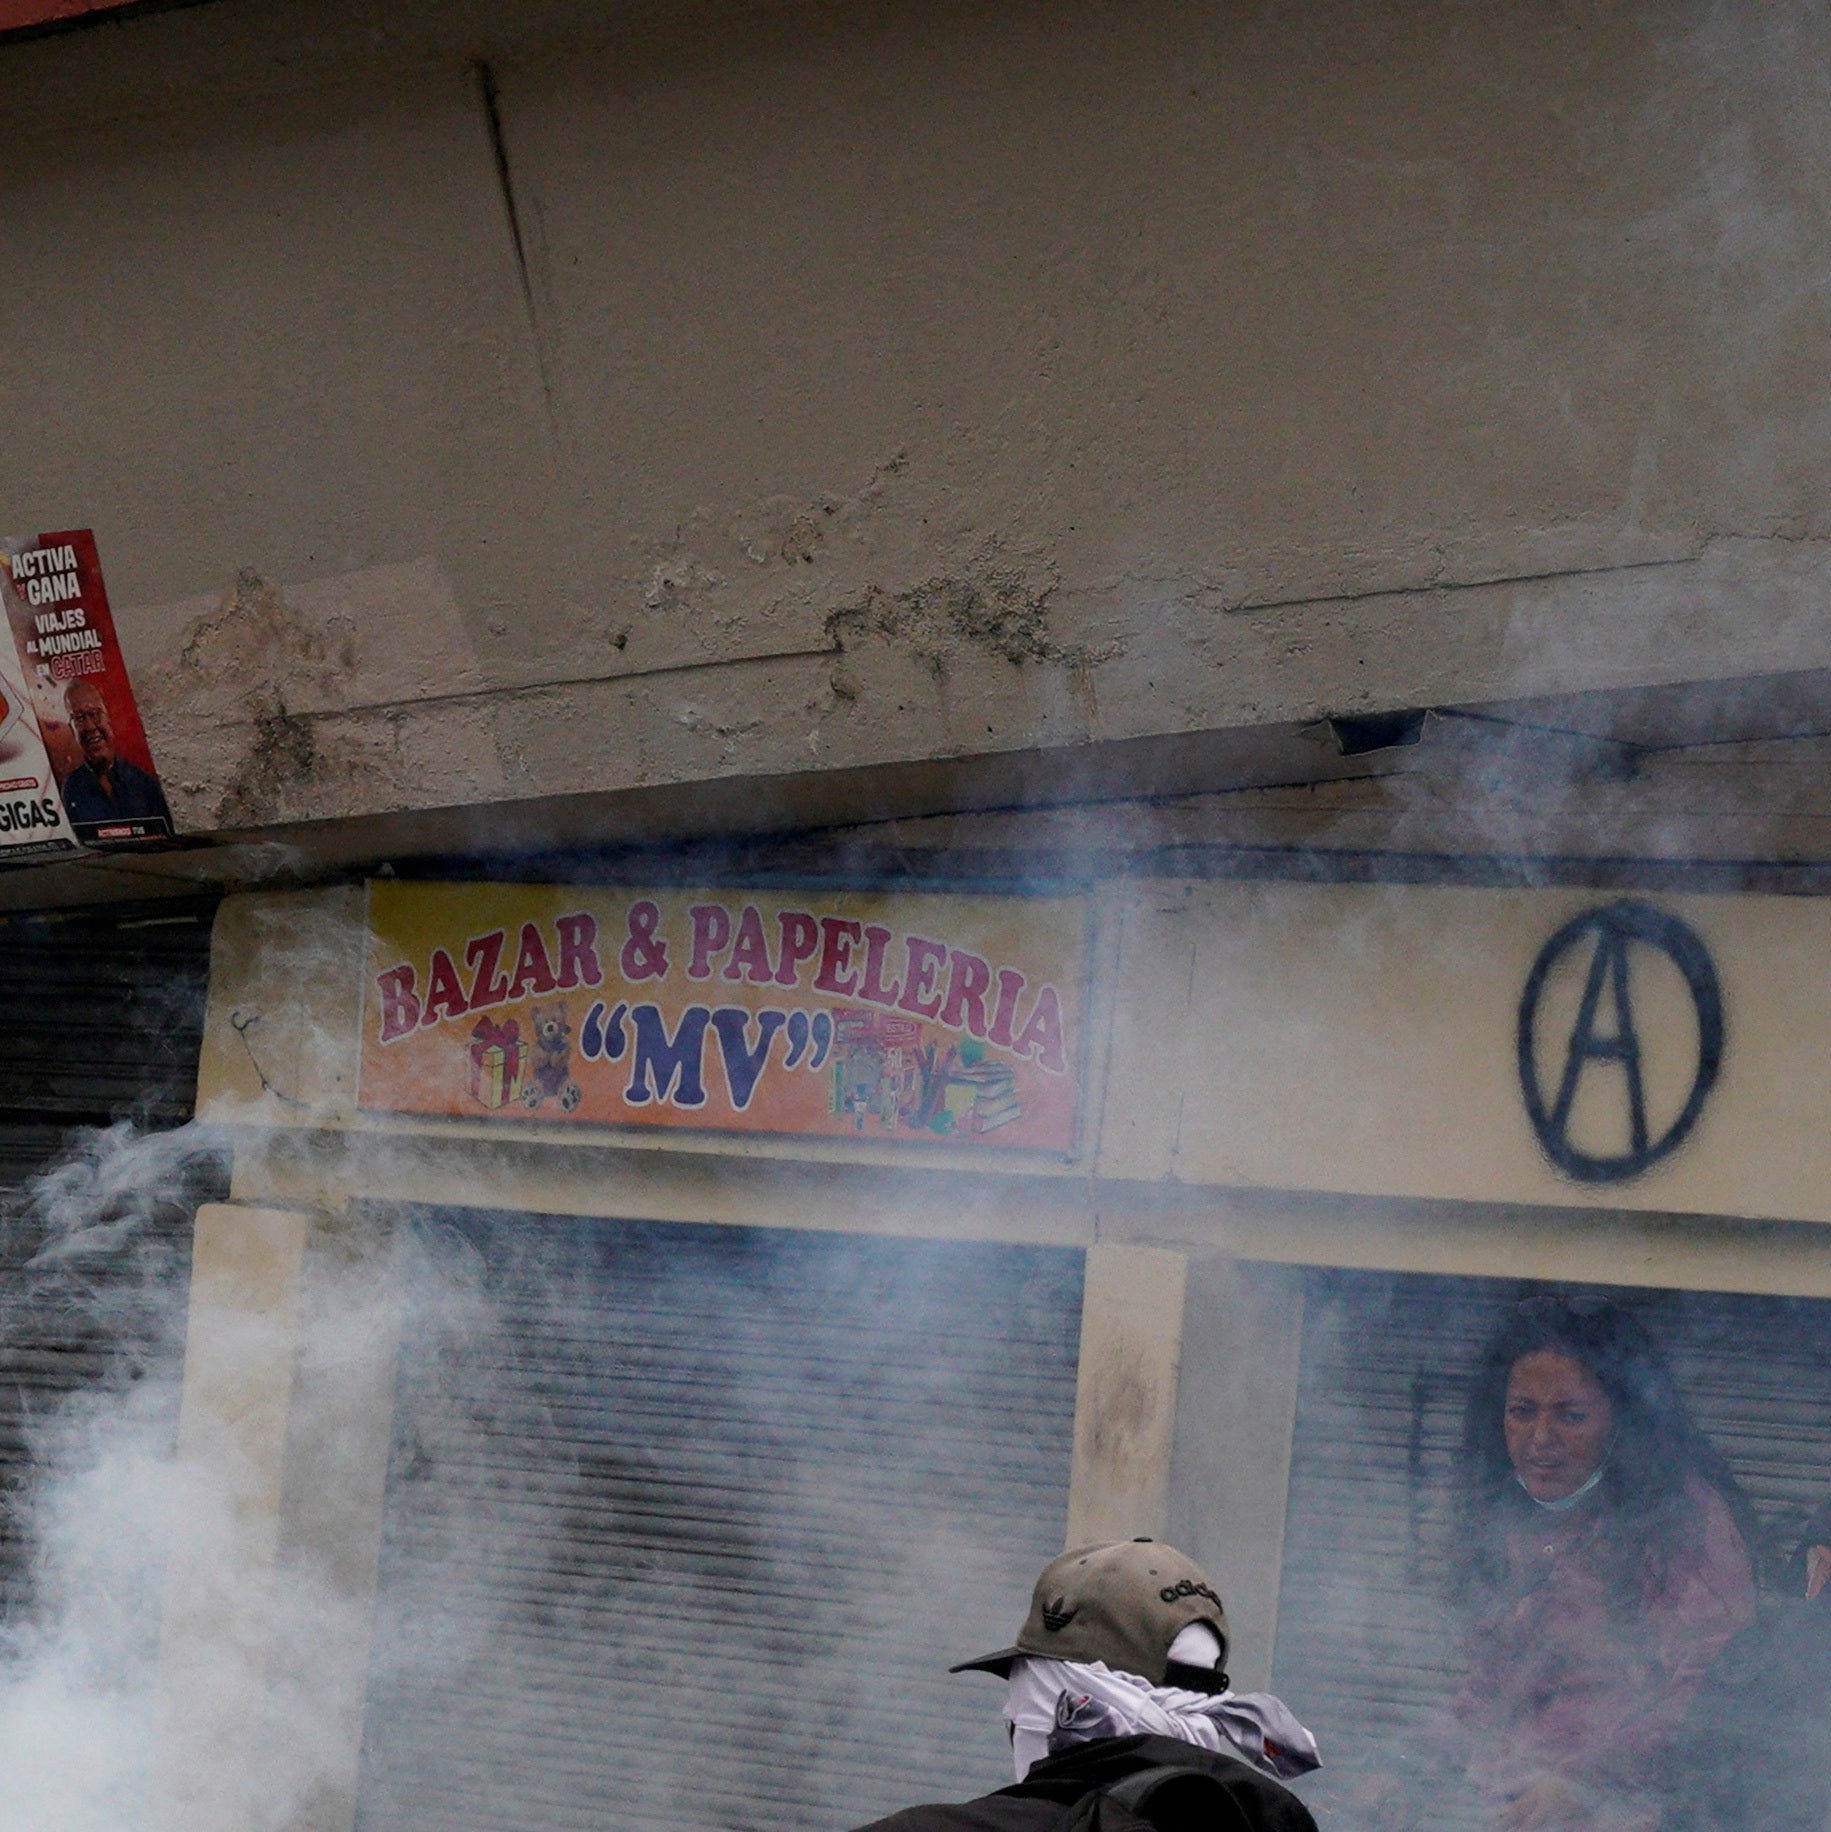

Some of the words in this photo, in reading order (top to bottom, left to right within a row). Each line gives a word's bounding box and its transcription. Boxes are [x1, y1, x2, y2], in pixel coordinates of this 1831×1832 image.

[12, 545, 78, 580] ACTIVA
[27, 572, 82, 605] GANA
[35, 607, 87, 634] VIAJES
[38, 628, 102, 657] MUNDIAL
[48, 649, 106, 680] CATAR
[377, 911, 604, 1045] BAZAR
[620, 900, 669, 982] &
[687, 903, 1068, 1073] PAPELERIA
